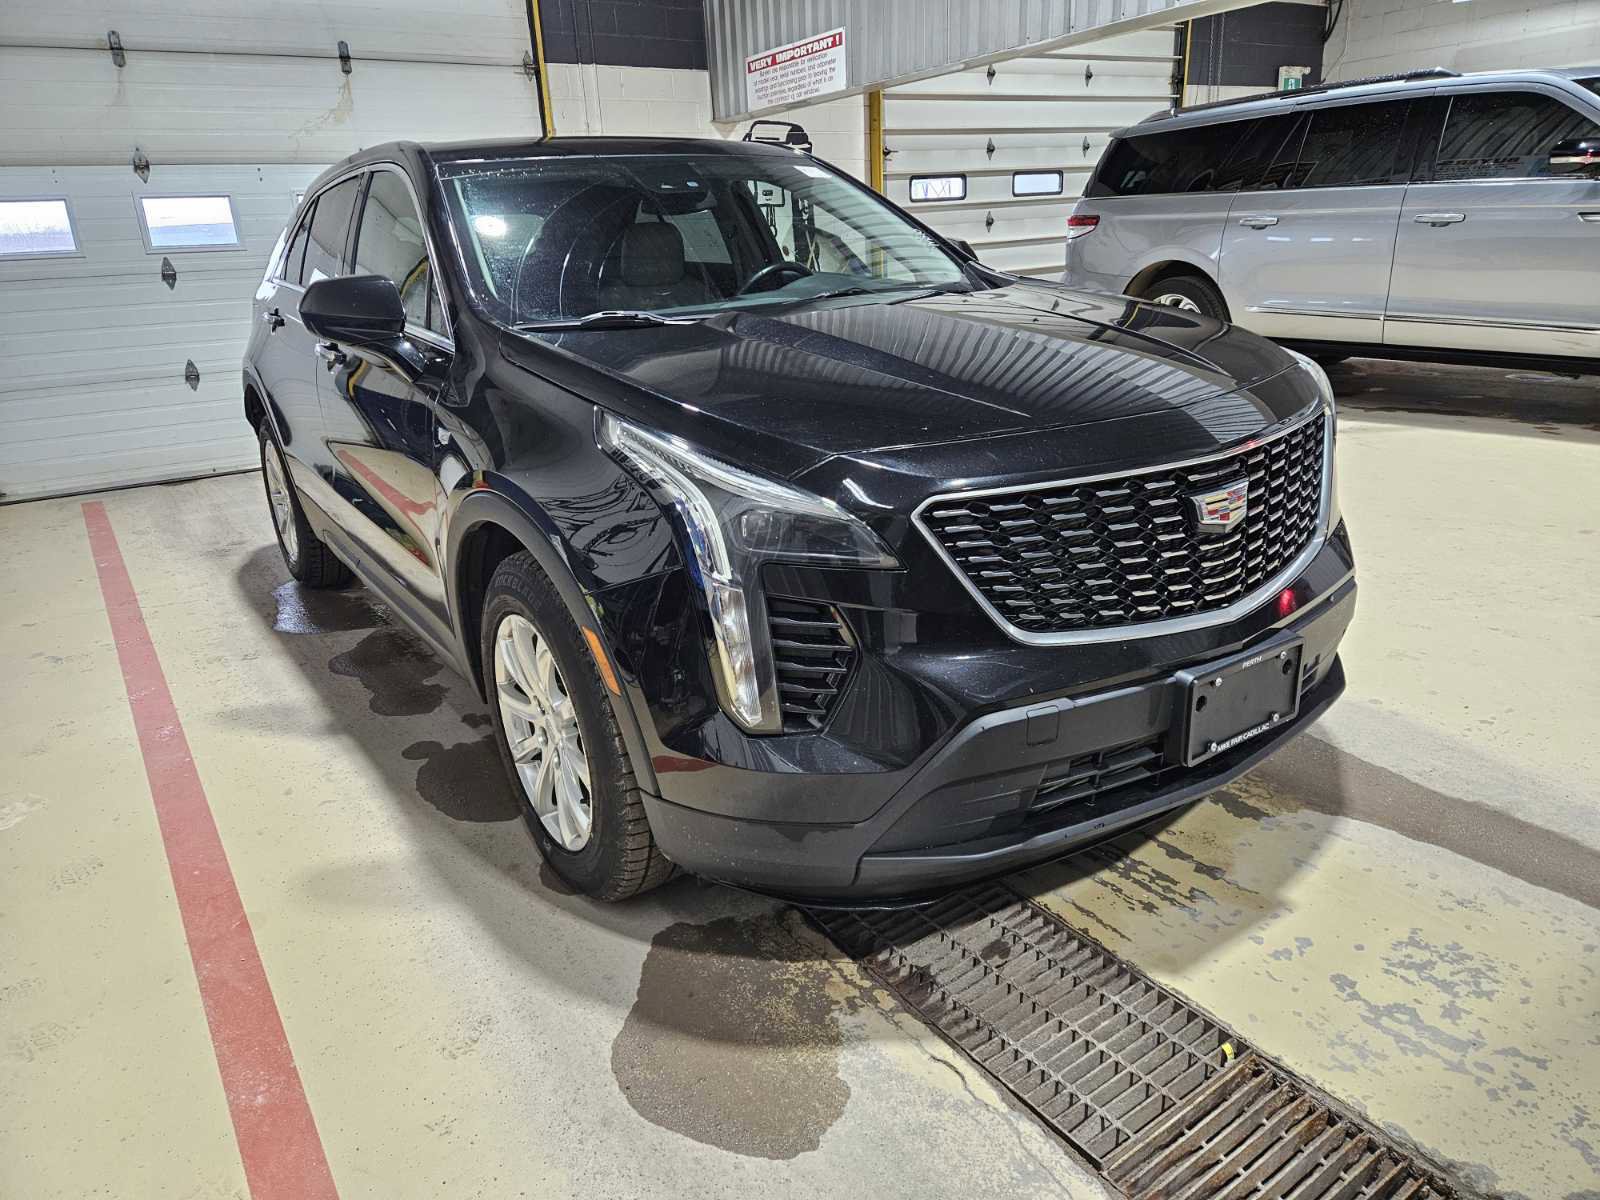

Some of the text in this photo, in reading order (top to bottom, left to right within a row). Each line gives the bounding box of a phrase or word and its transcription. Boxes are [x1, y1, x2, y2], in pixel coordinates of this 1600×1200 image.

[749, 35, 839, 71] VERY IMPORTANT !
[1243, 723, 1270, 739] CADILLAC
